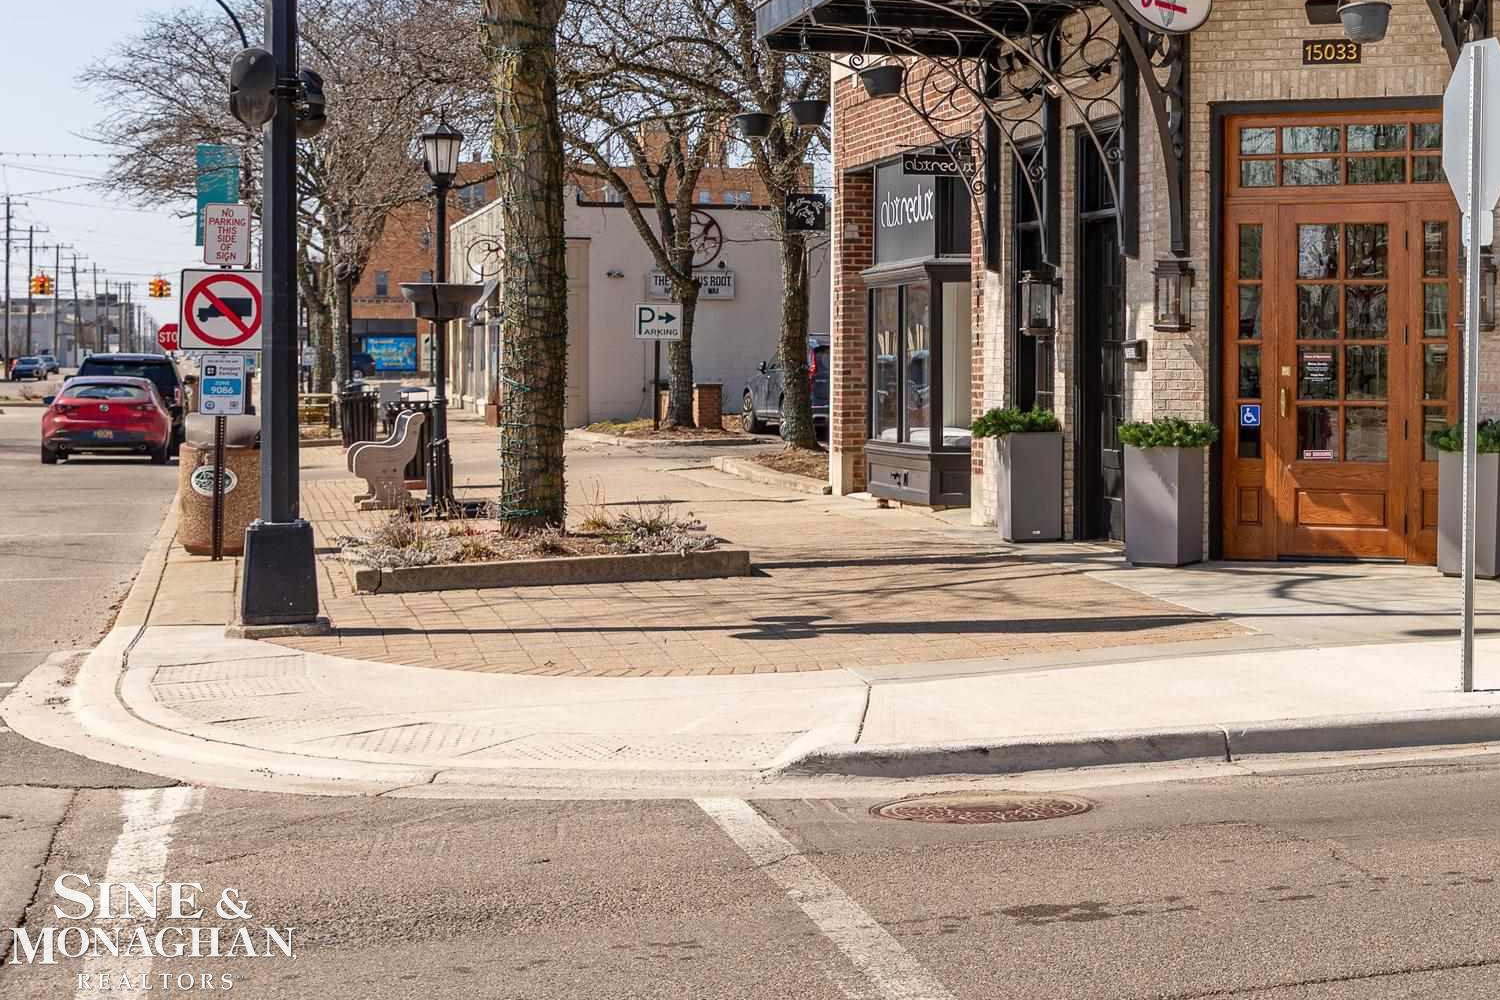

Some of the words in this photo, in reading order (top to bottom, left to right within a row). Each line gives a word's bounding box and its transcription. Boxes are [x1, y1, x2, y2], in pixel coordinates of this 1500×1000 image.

[1305, 43, 1357, 61] 15033
[222, 208, 234, 218] NO
[208, 217, 246, 227] PARKING
[217, 226, 237, 235] THIS
[217, 234, 237, 243] SIDE
[220, 242, 232, 252] OF
[216, 251, 236, 261] SIGN
[655, 276, 670, 287] THE
[160, 331, 176, 343] STO
[211, 386, 233, 394] 9086
